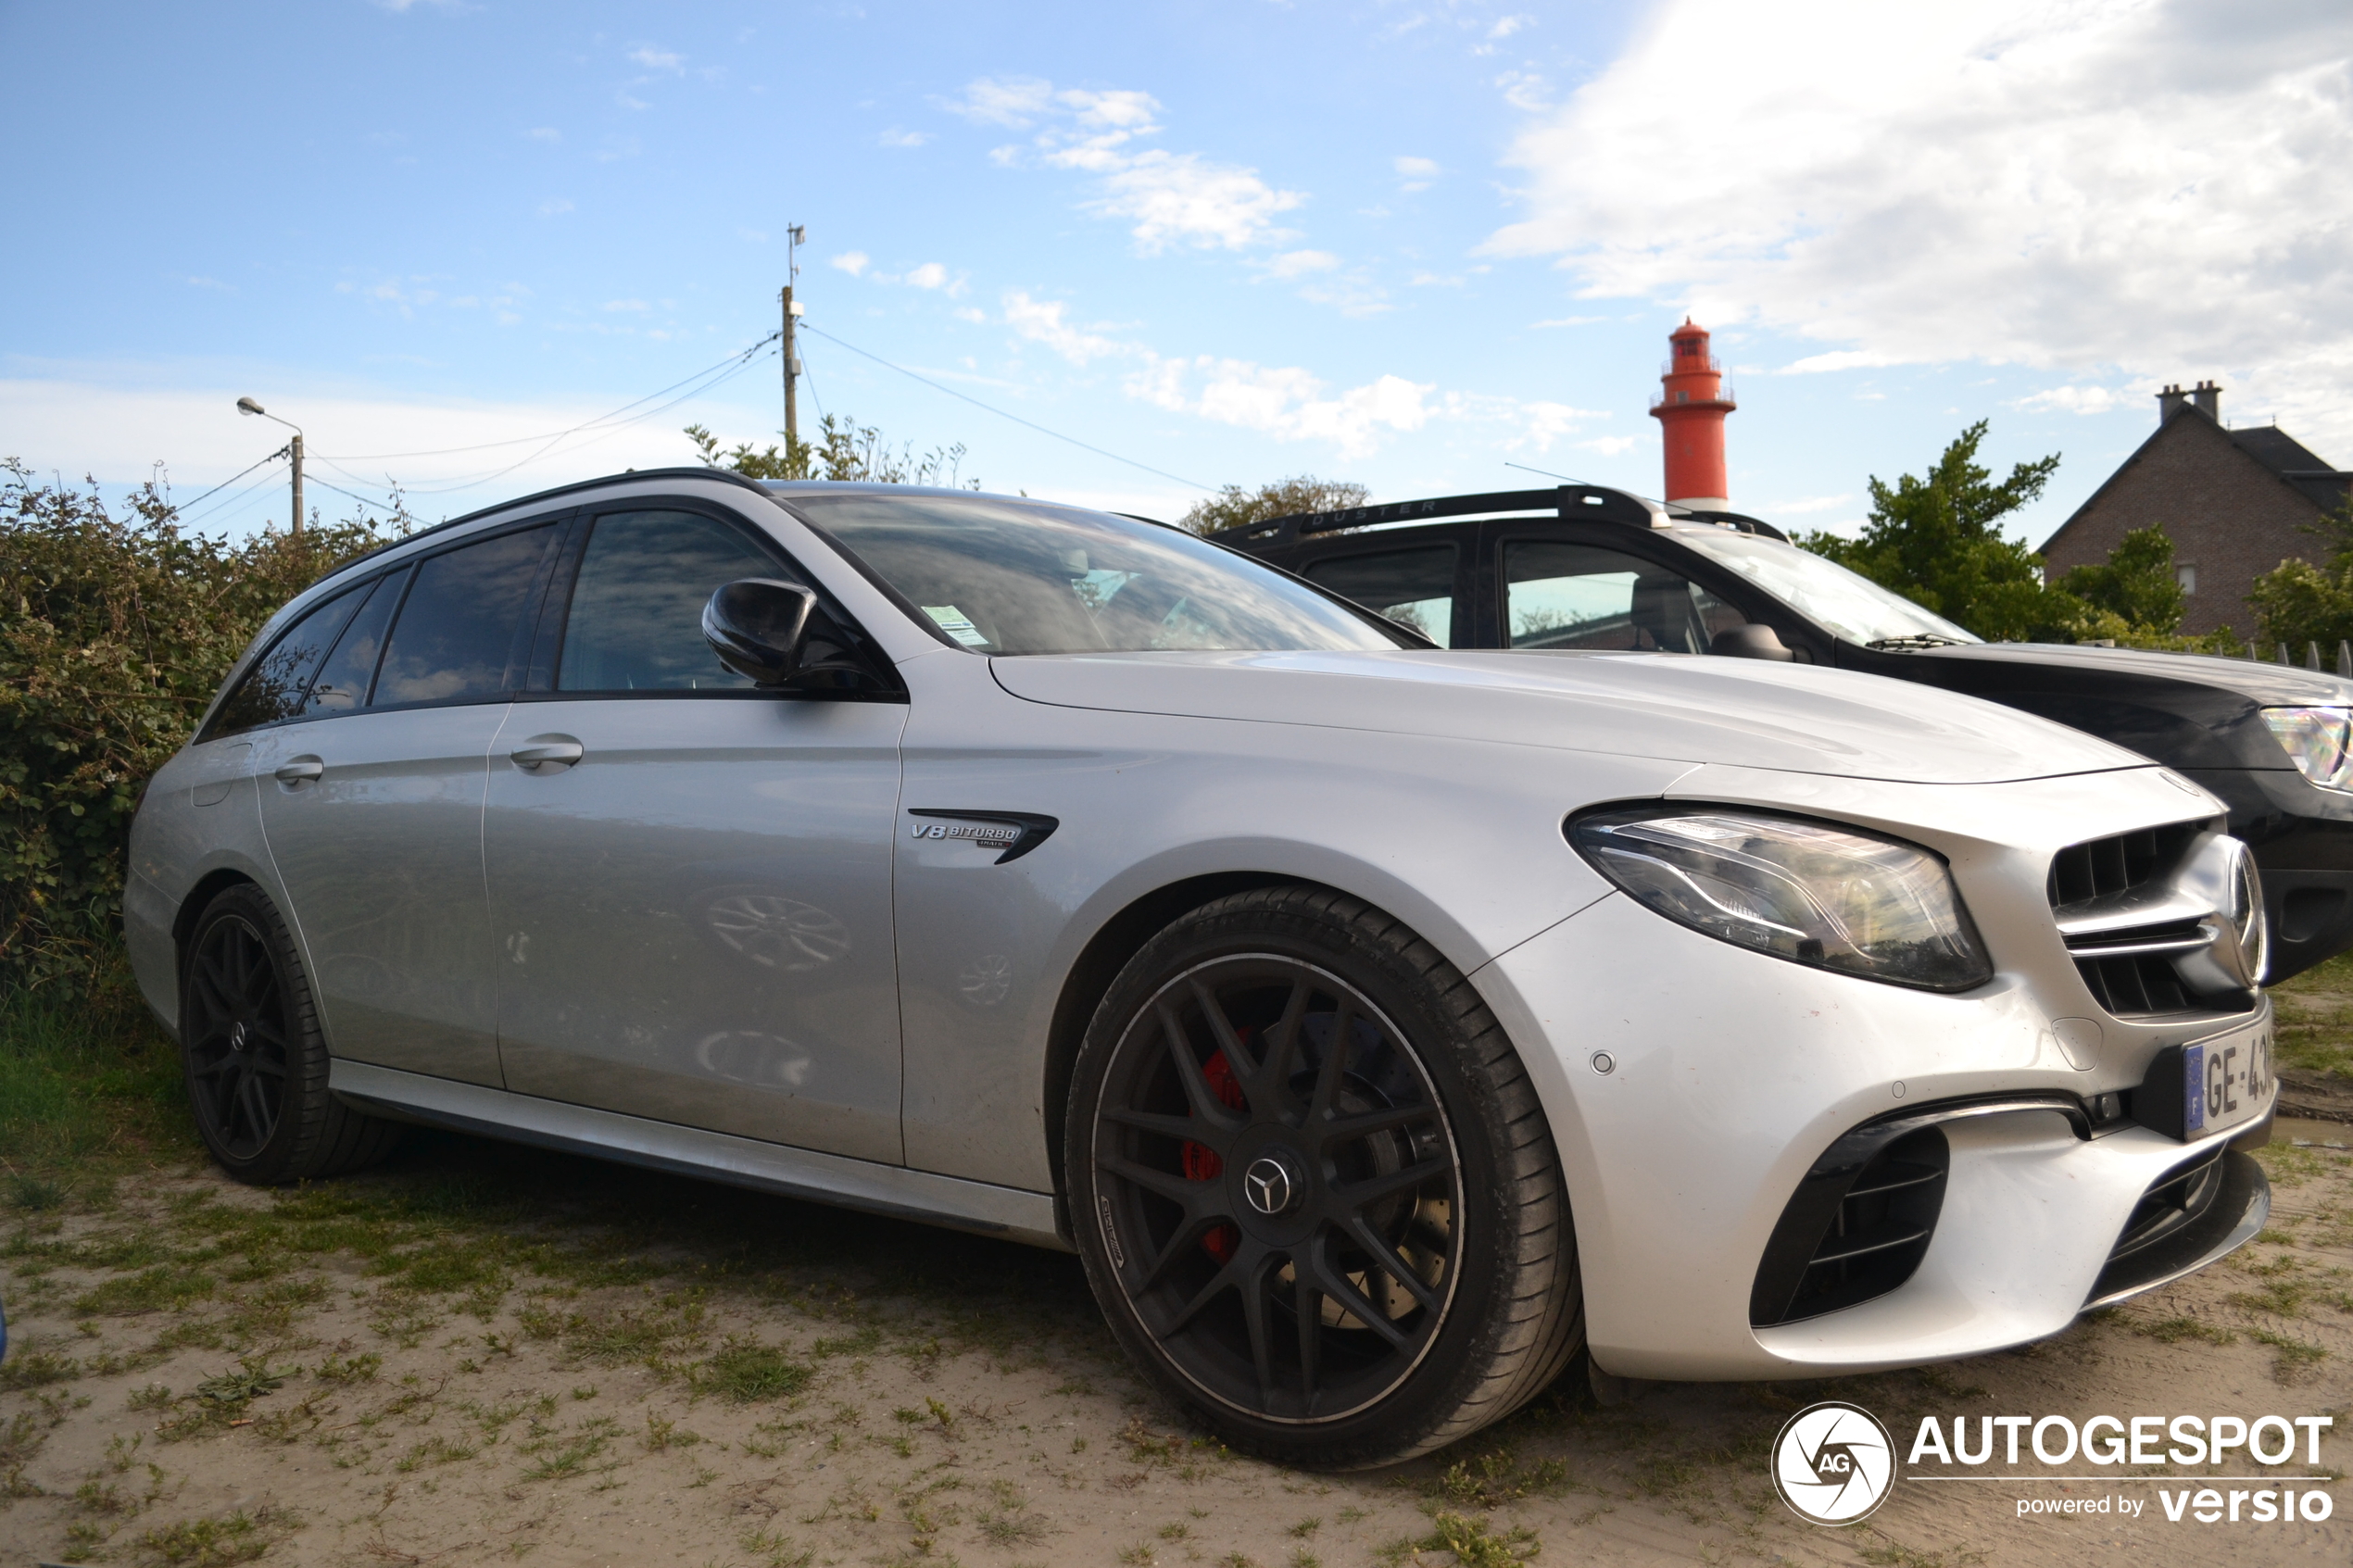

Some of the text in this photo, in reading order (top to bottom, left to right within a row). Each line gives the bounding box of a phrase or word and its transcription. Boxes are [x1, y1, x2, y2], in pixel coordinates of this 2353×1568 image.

[1312, 501, 1436, 526] DUSTER
[911, 824, 1017, 840] V8 BITURBO
[1365, 950, 1408, 985] PILOT
[2207, 1030, 2271, 1118] GE-43
[1101, 1200, 1118, 1251] AMG
